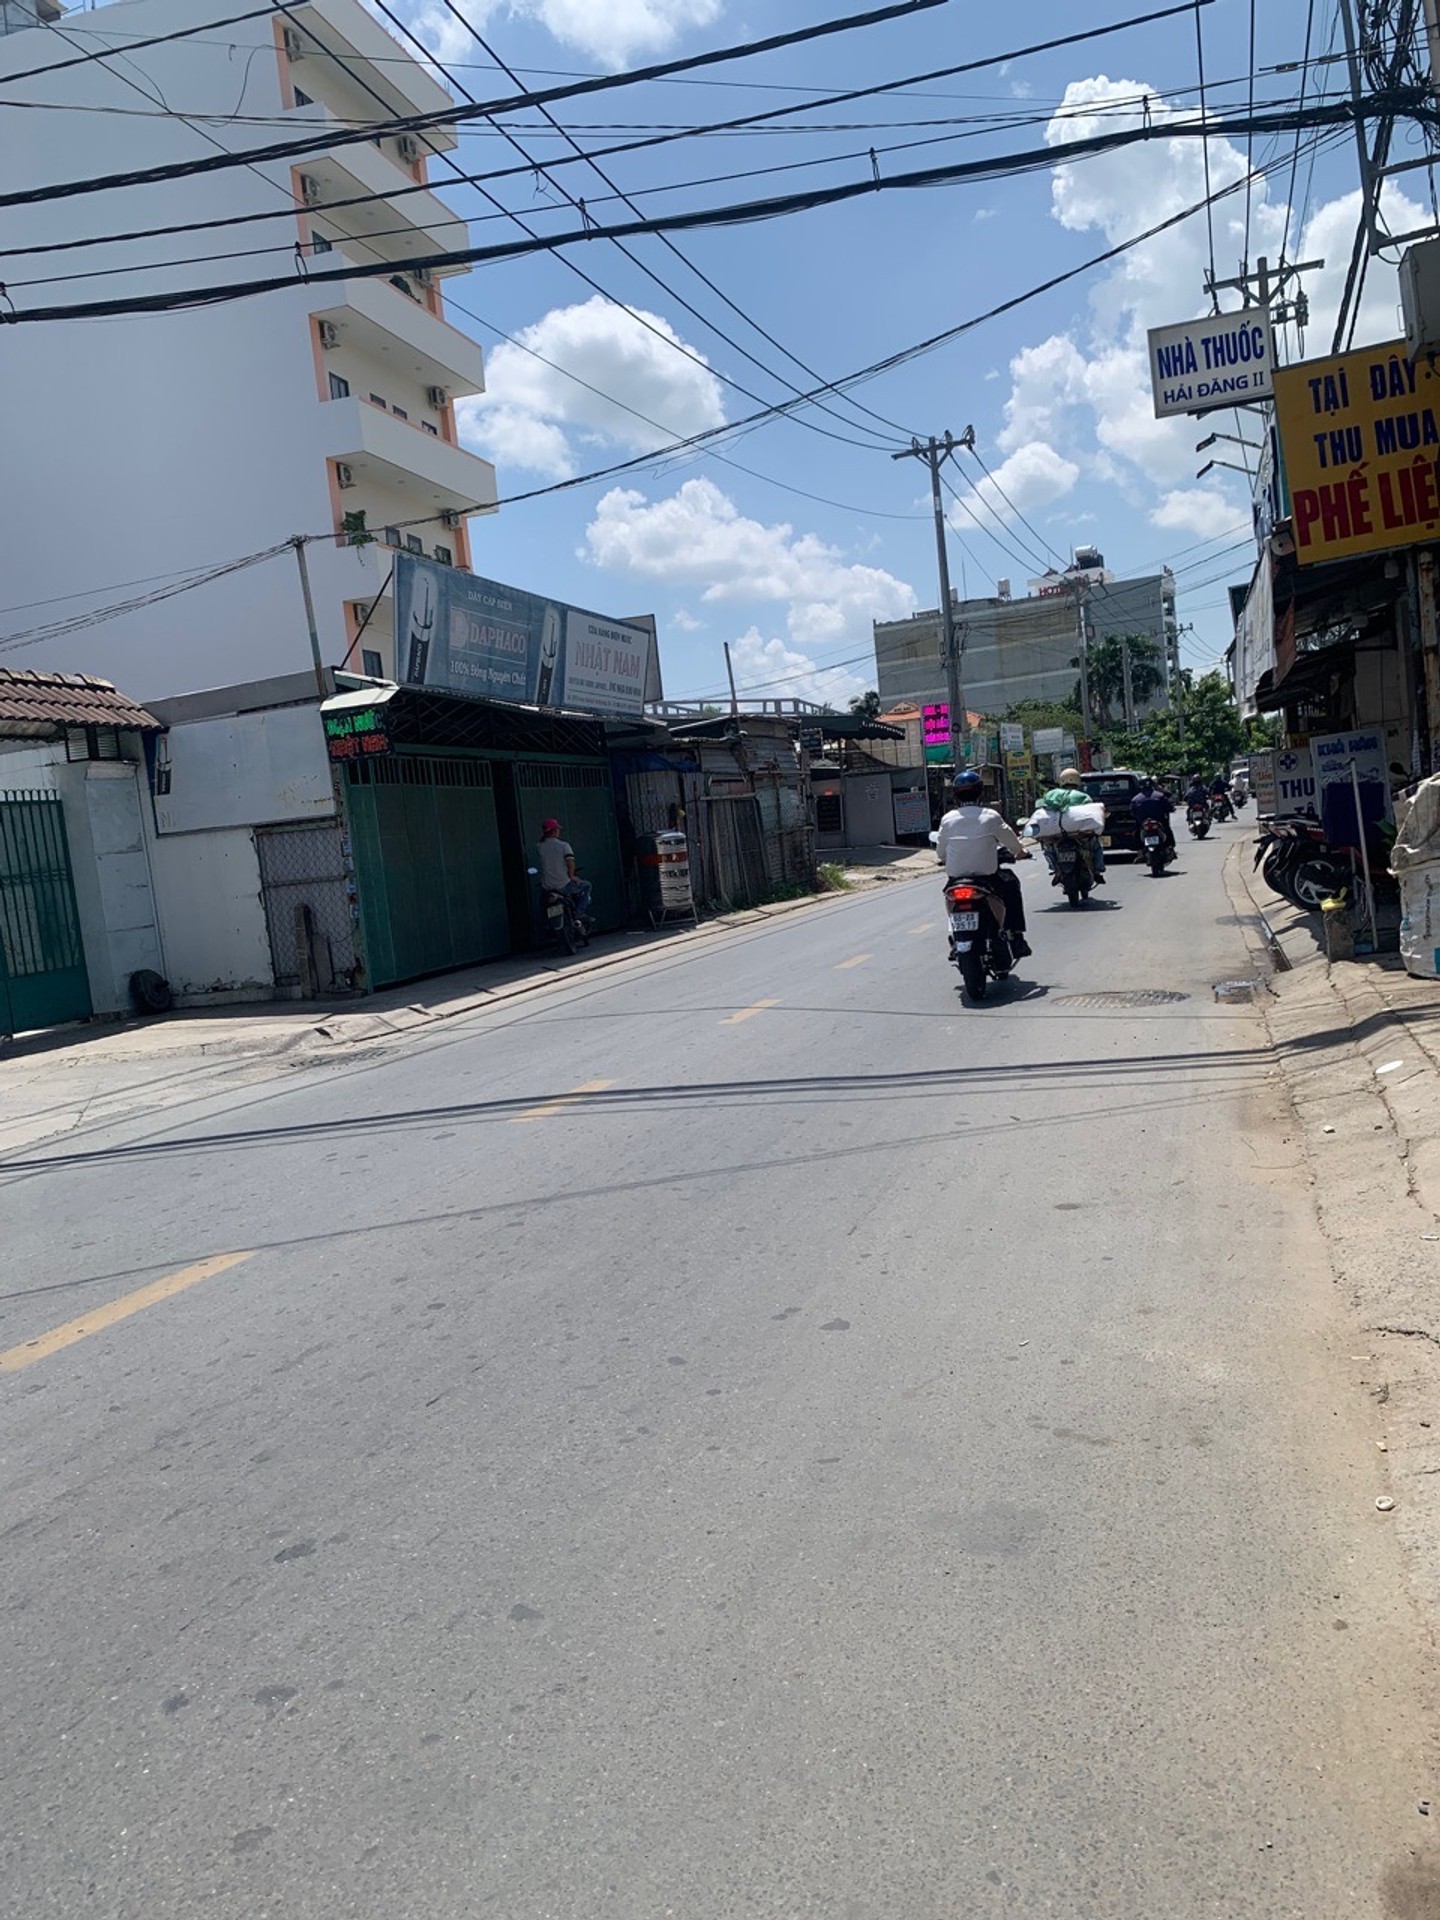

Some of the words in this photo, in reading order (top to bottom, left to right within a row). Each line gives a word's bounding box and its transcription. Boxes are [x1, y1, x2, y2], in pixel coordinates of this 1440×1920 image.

[1156, 336, 1198, 380] NHÀ
[1200, 320, 1265, 371] THUỐC
[1163, 382, 1192, 404] HẢI
[1197, 375, 1249, 398] ĐĂNG
[1253, 370, 1265, 387] II
[1313, 426, 1363, 469] THU
[1374, 408, 1439, 456] MUA
[1292, 462, 1374, 547] PHẾ
[1377, 453, 1440, 531] LIỆ
[470, 622, 527, 654] DAPHACO
[575, 640, 611, 676] NHẬT
[613, 650, 641, 679] NAM
